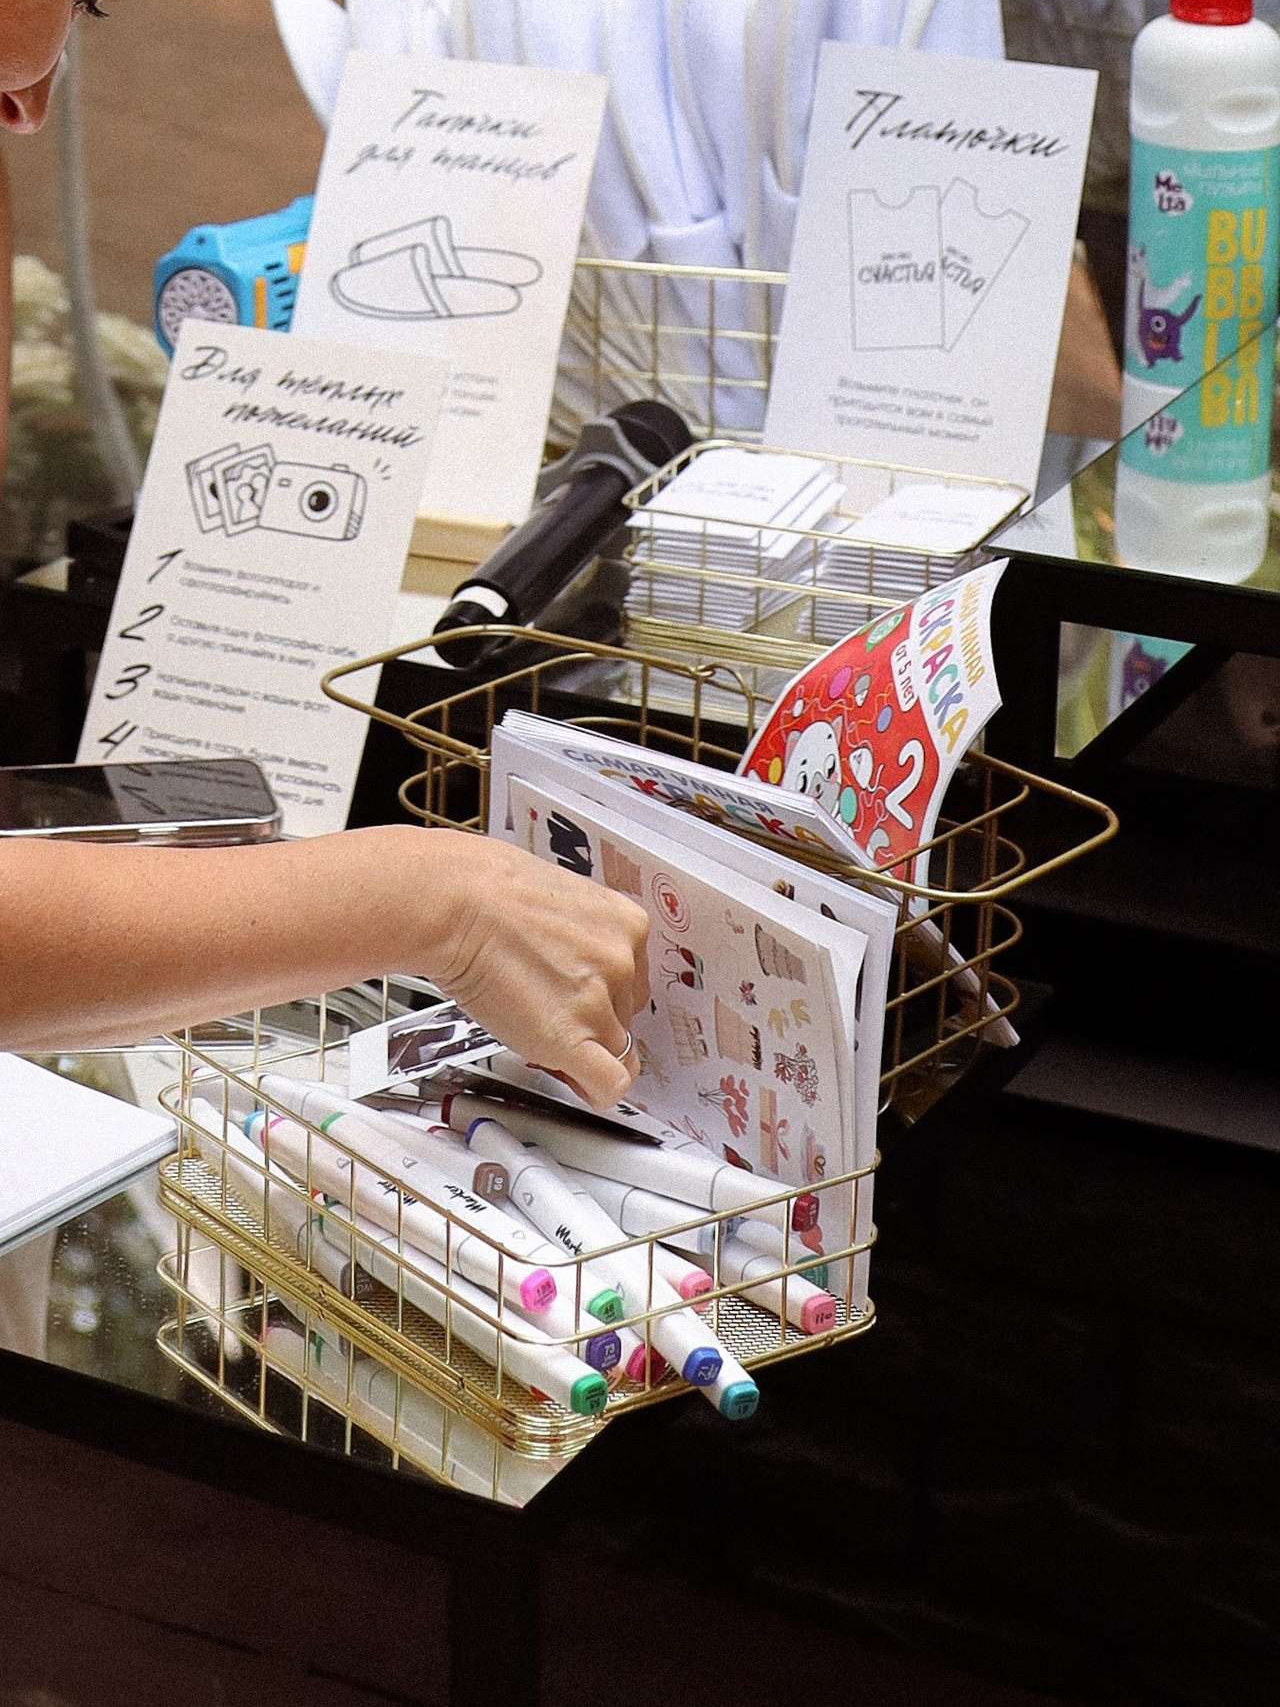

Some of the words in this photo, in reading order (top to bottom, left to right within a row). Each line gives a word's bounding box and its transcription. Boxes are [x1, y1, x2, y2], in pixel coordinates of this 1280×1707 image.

[391, 88, 537, 139] Тапочки
[845, 89, 1071, 151] Платочки
[345, 143, 417, 175] для
[431, 147, 578, 184] танцев
[180, 345, 263, 394] Для
[222, 401, 427, 448] пожеланий
[148, 548, 183, 585] 1
[118, 604, 164, 642] 2
[106, 664, 151, 701] 3
[99, 720, 138, 760] 4
[561, 747, 668, 783] САМАЯ
[670, 770, 776, 817] УМНАЯ
[884, 737, 926, 832] 2
[443, 1184, 487, 1213] Marker
